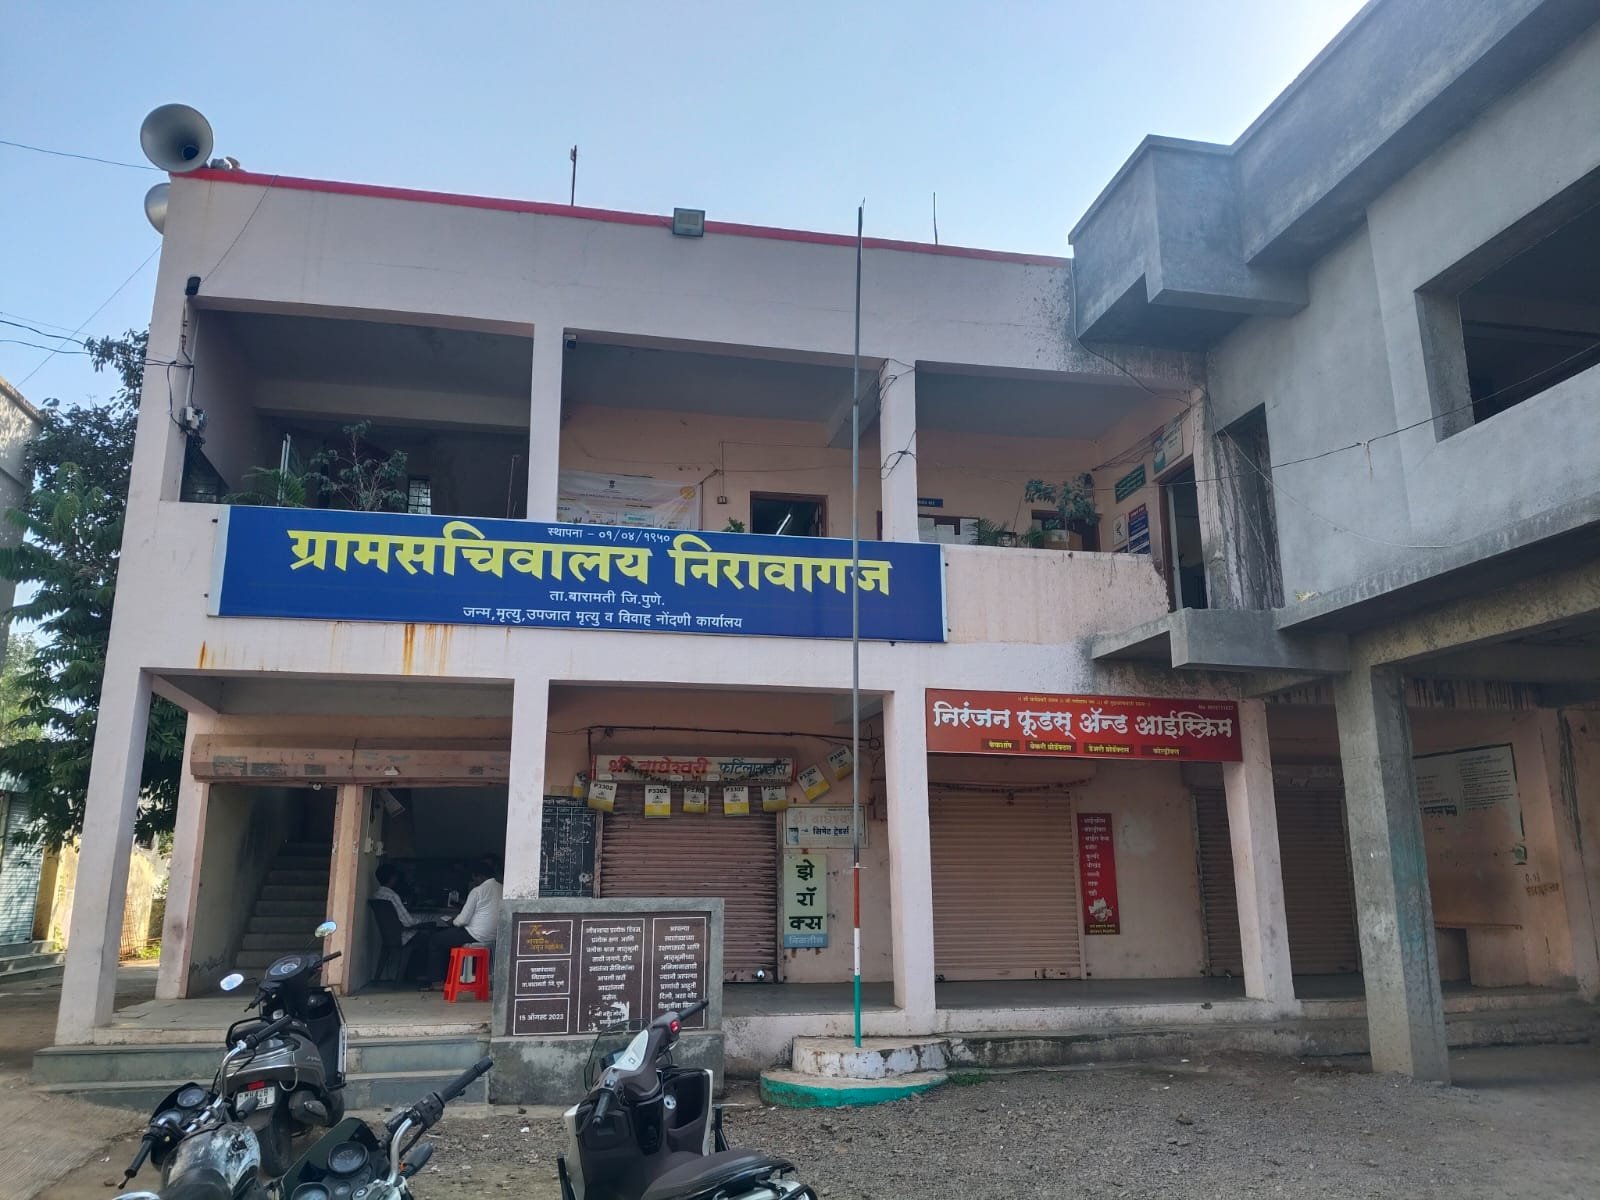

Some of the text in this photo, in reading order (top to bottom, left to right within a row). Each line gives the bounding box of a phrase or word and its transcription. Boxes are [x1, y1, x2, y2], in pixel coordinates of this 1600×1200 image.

[548, 527, 582, 538] स्थापना
[288, 521, 892, 596] ग्रामसचिवालय निरावागज
[549, 590, 664, 608] ता.बारामती जि.पुणे.
[576, 611, 599, 626] मृत्यु
[605, 613, 612, 622] व
[618, 611, 650, 626] विवाह
[656, 612, 691, 626] नोंदणी
[696, 614, 742, 628] कार्यालय
[933, 701, 1011, 728] निरंजन
[1017, 710, 1076, 739] फूडस्
[609, 755, 633, 772] श्री
